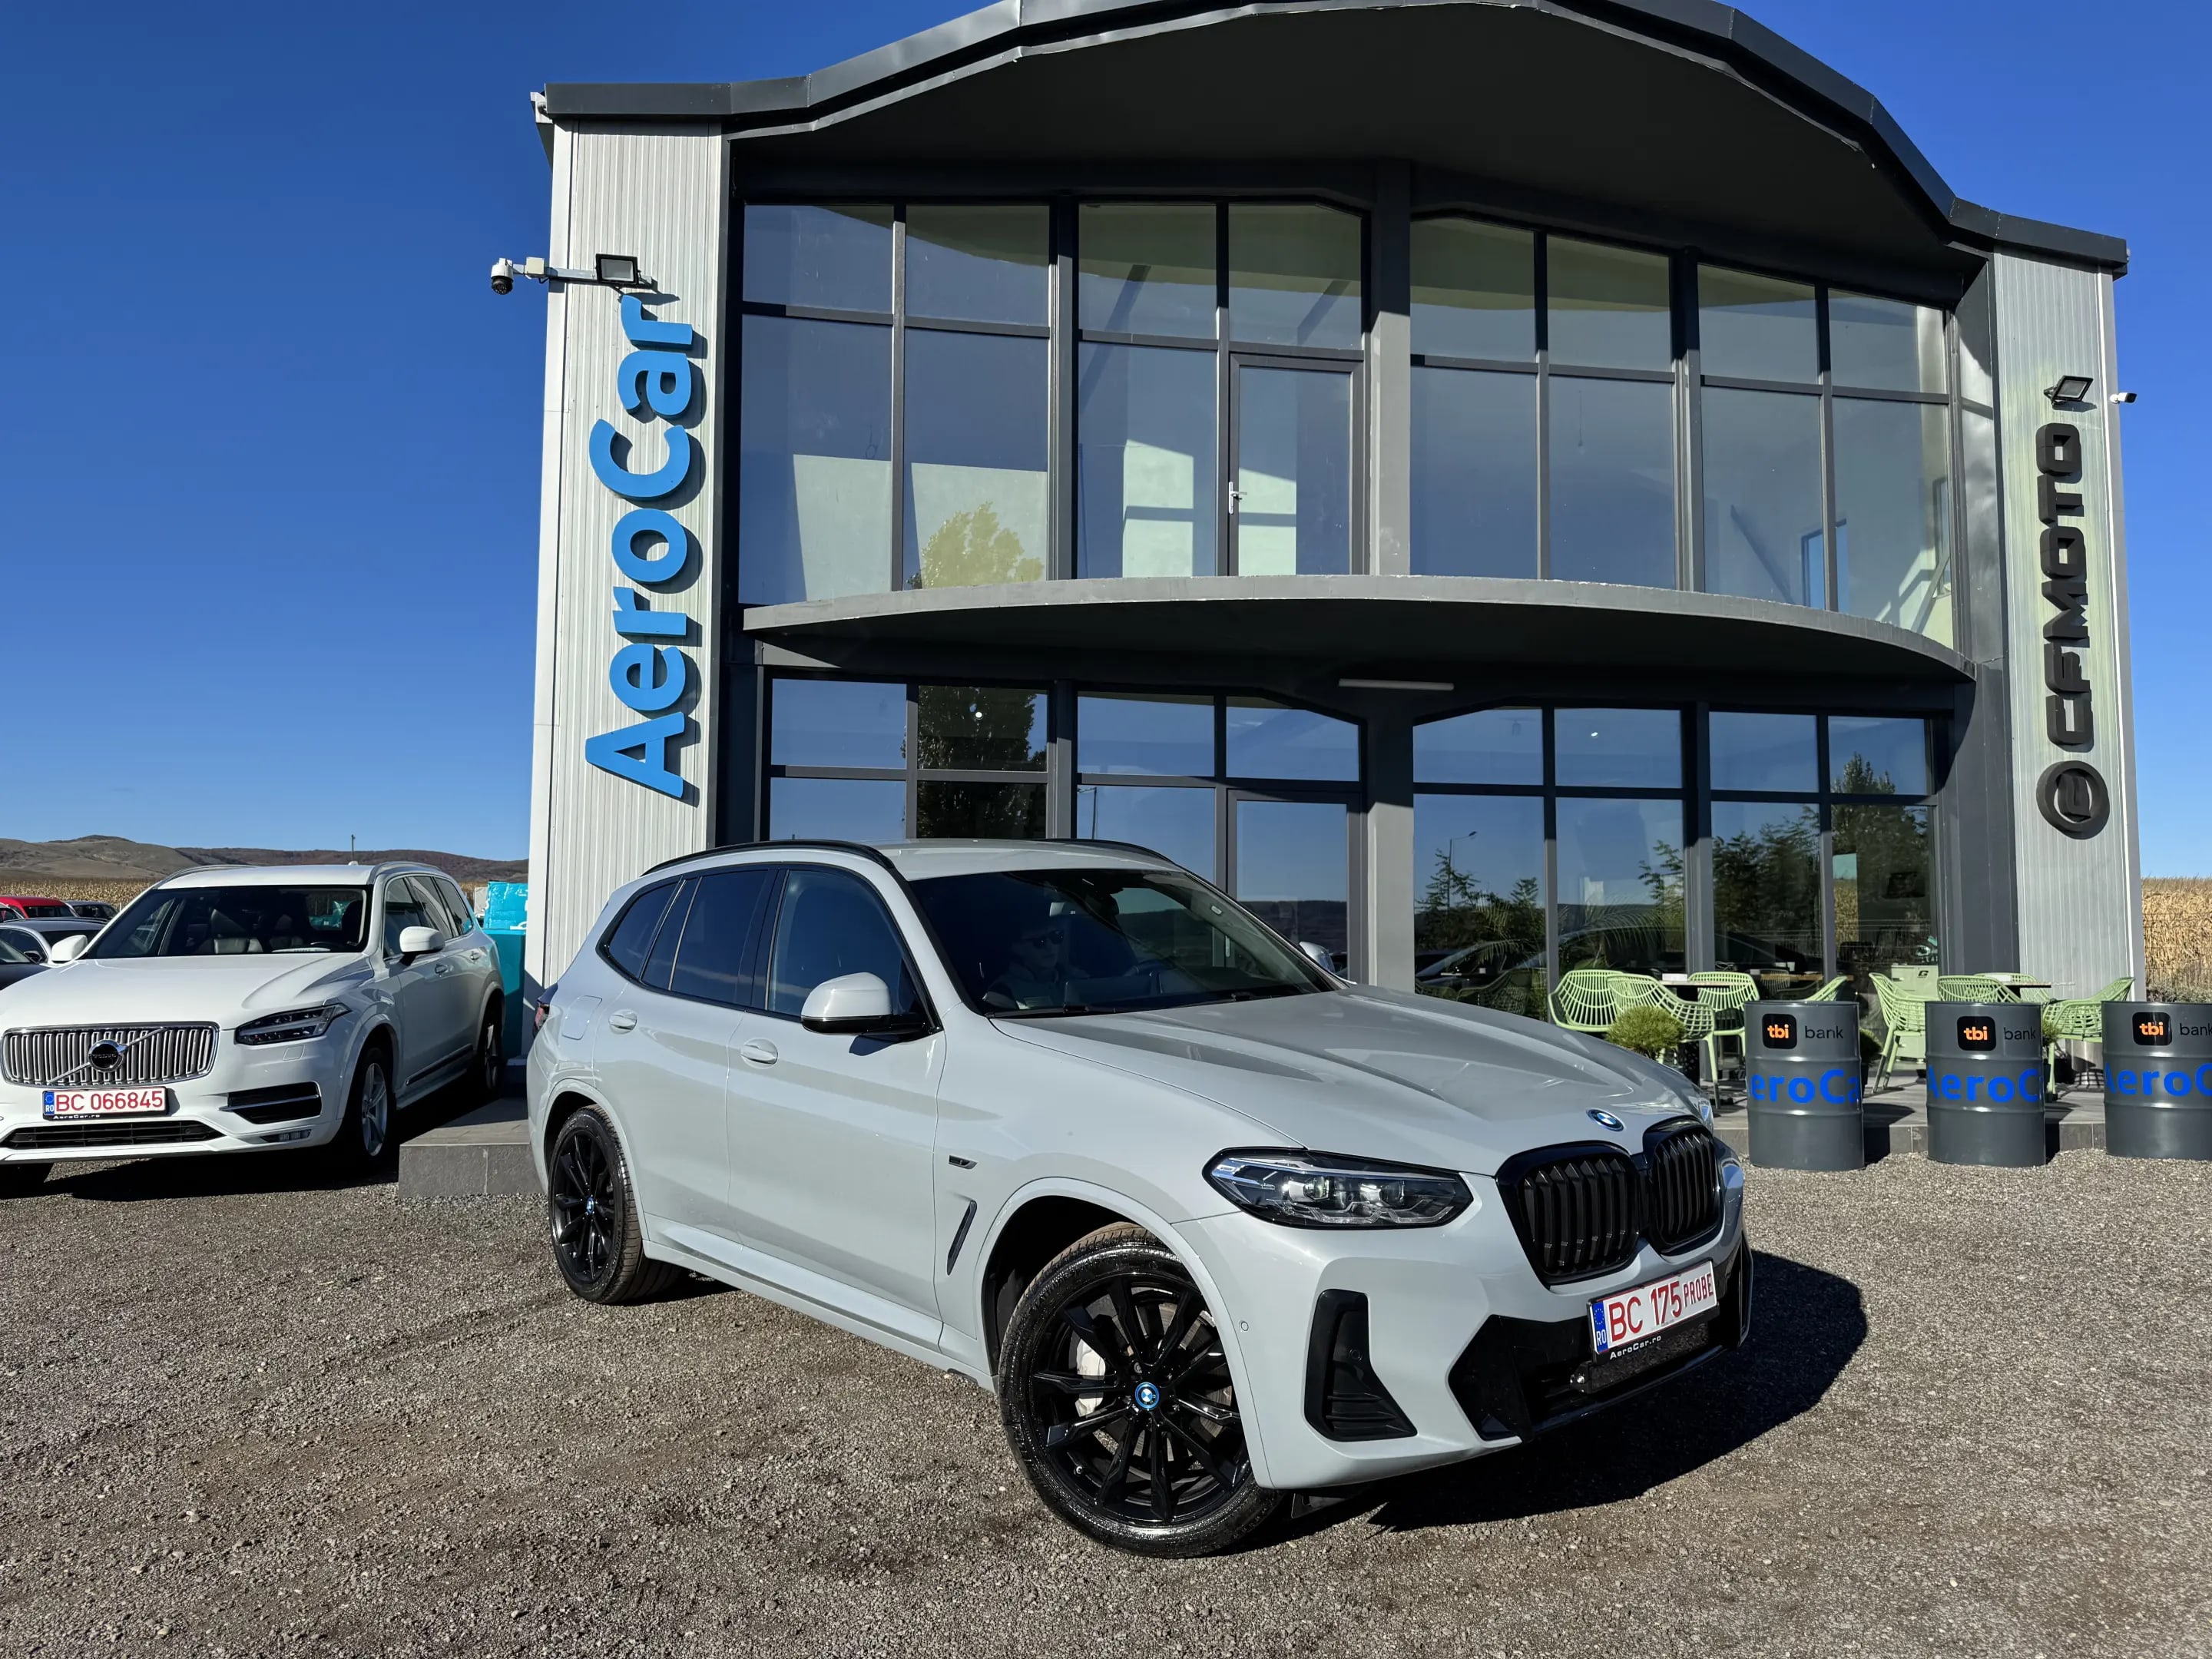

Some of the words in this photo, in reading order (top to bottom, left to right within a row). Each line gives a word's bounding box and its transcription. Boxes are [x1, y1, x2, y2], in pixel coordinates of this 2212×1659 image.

[585, 295, 693, 799] AeroCar
[2036, 423, 2094, 752] CFMOTO
[1767, 1024, 1790, 1038] tbi
[1805, 1025, 1843, 1039] bank
[1963, 1026, 1988, 1041] tbi
[2003, 1027, 2036, 1040] bank
[2139, 1022, 2164, 1035] tbi
[45, 1104, 55, 1113] RO
[56, 1094, 84, 1111] BC
[90, 1091, 163, 1110] 066845
[1596, 1330, 1607, 1346] RO
[1608, 1296, 1643, 1343] BC
[1650, 1280, 1682, 1326] 175
[1683, 1273, 1714, 1307] PROBE
[1610, 1335, 1661, 1359] AeroCar.ro
